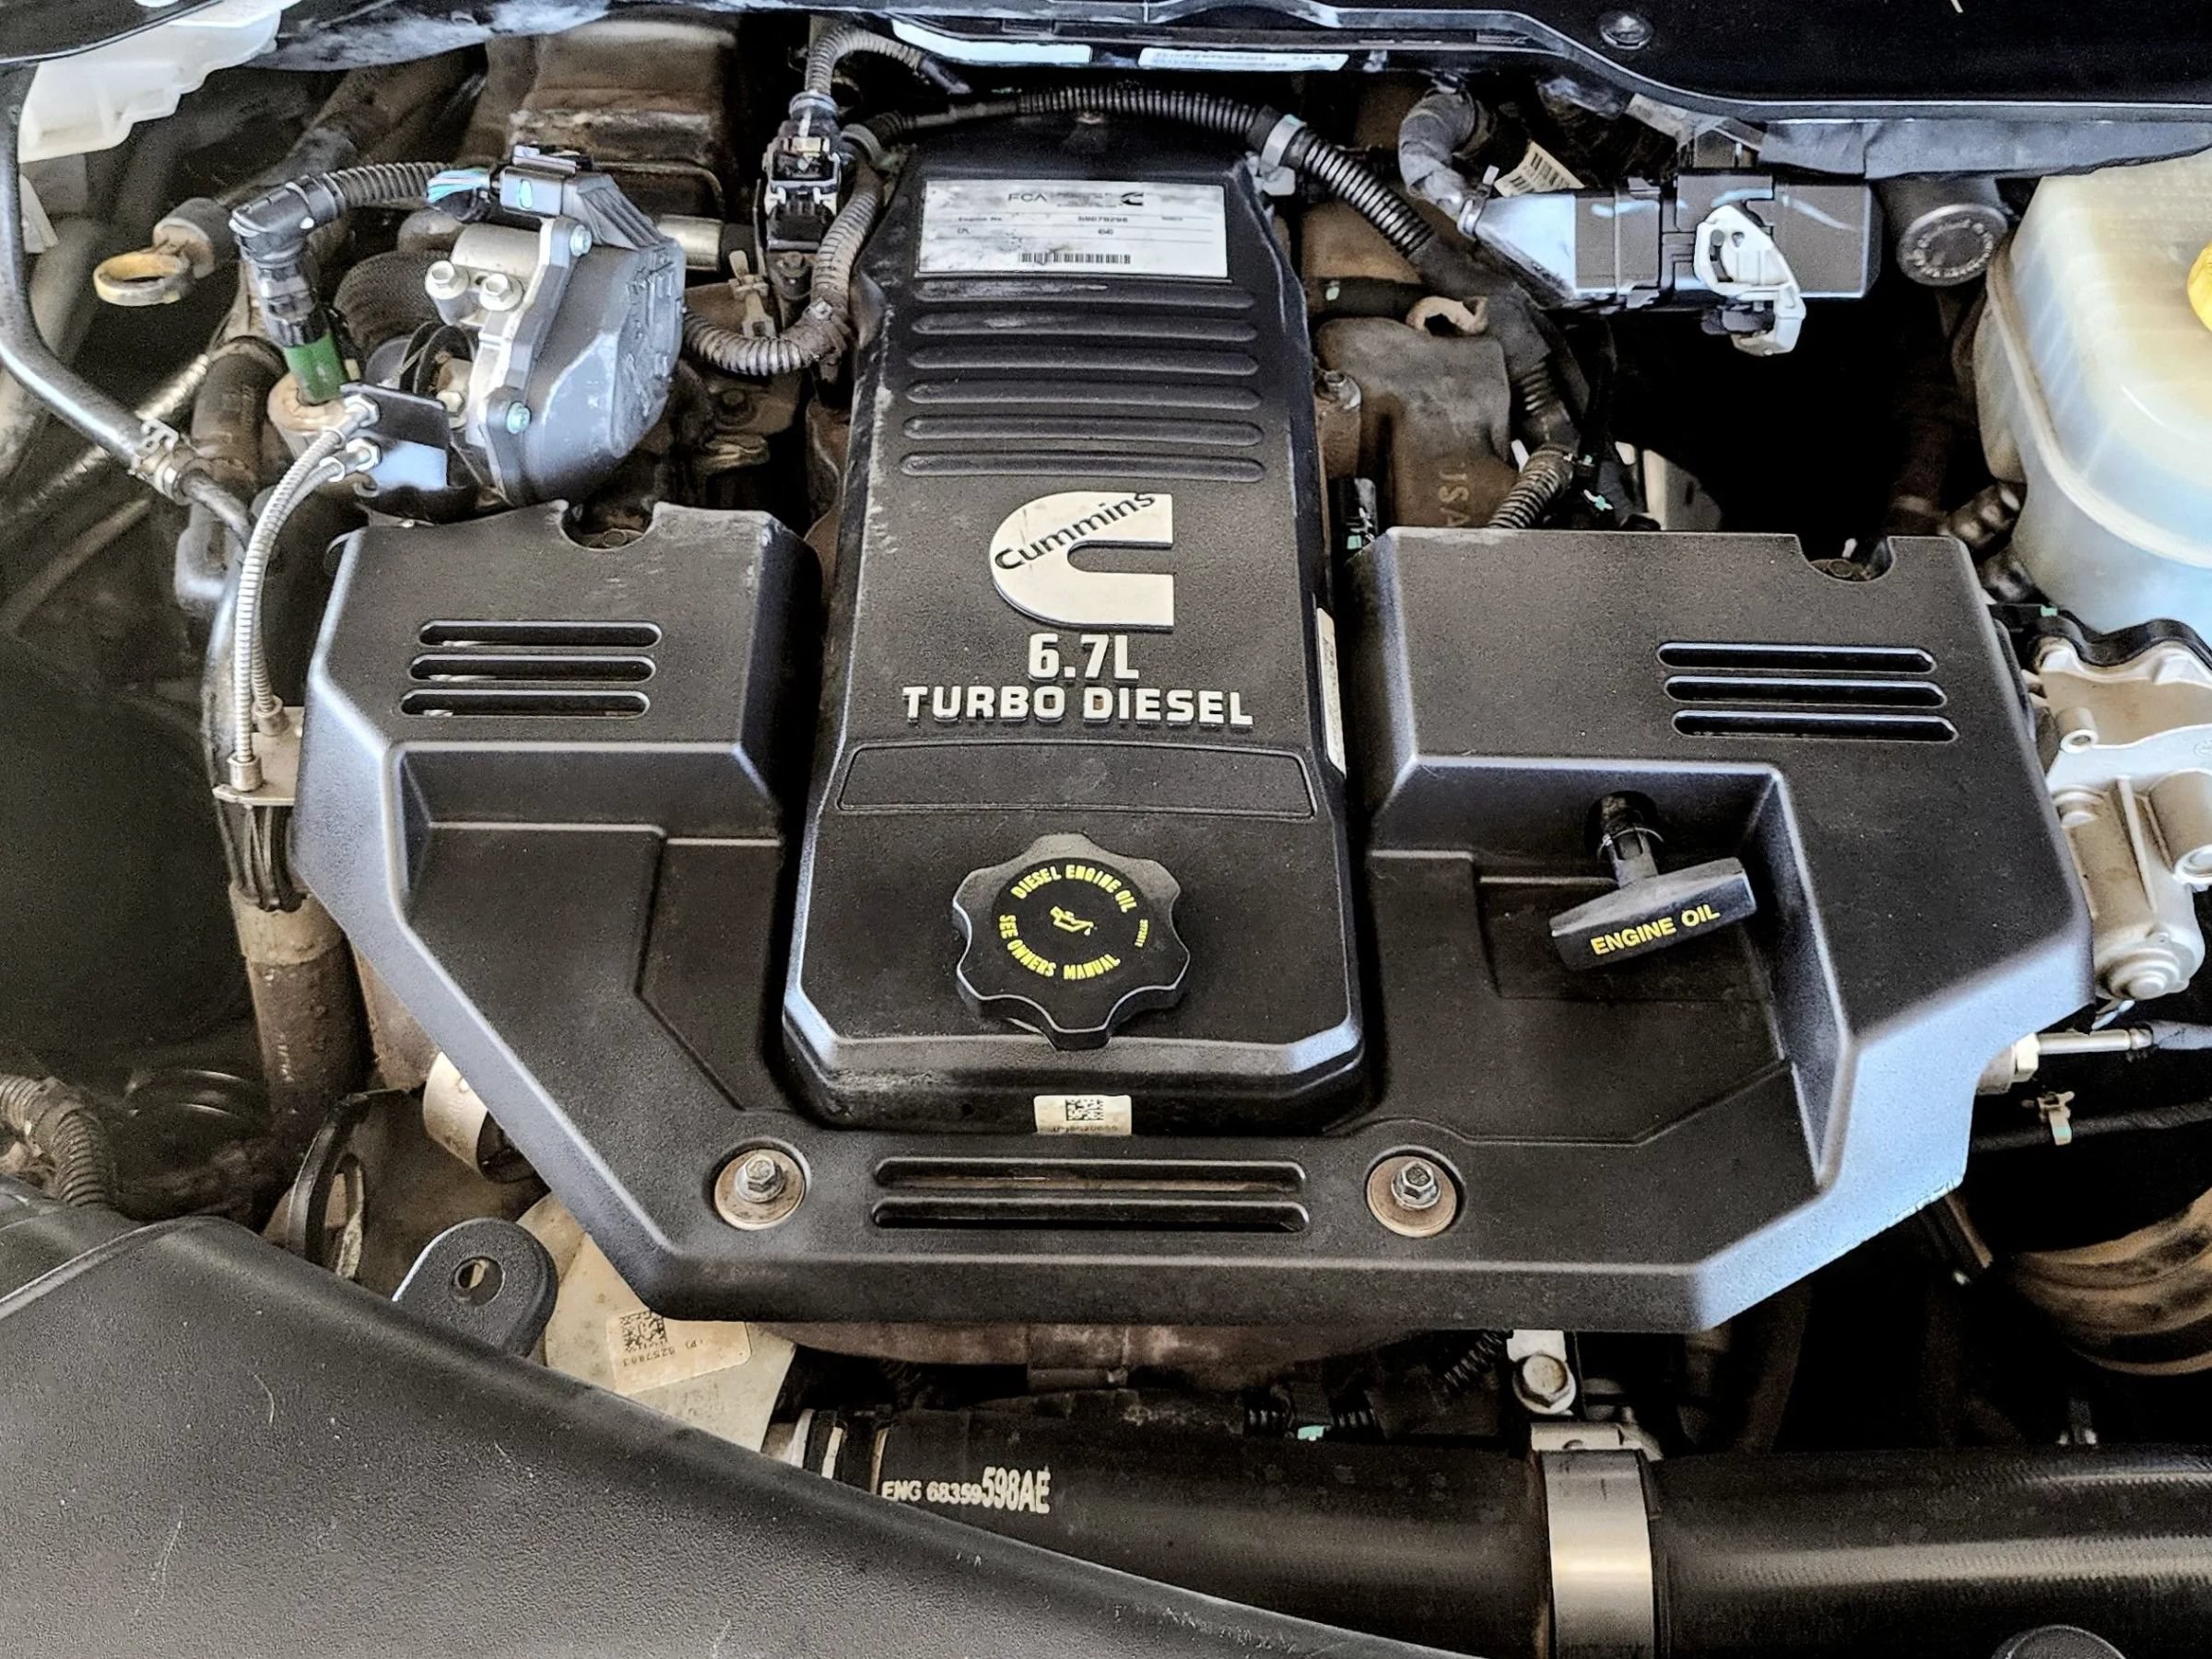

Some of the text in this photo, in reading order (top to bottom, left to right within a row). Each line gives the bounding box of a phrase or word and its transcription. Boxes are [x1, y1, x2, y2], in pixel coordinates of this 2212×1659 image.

[1007, 193, 1048, 203] FCA
[994, 491, 1157, 570] Cummins
[1028, 632, 1140, 681] 6.7L
[902, 685, 1254, 729] TURBO DIESEL
[1010, 864, 1137, 913] DIESEL ENGINE OIL
[998, 914, 1019, 939] SEE
[1063, 953, 1122, 981] MANUAL
[1590, 904, 1721, 956] ENGINE OIL
[881, 1465, 1052, 1513] ENG 68359598AE
